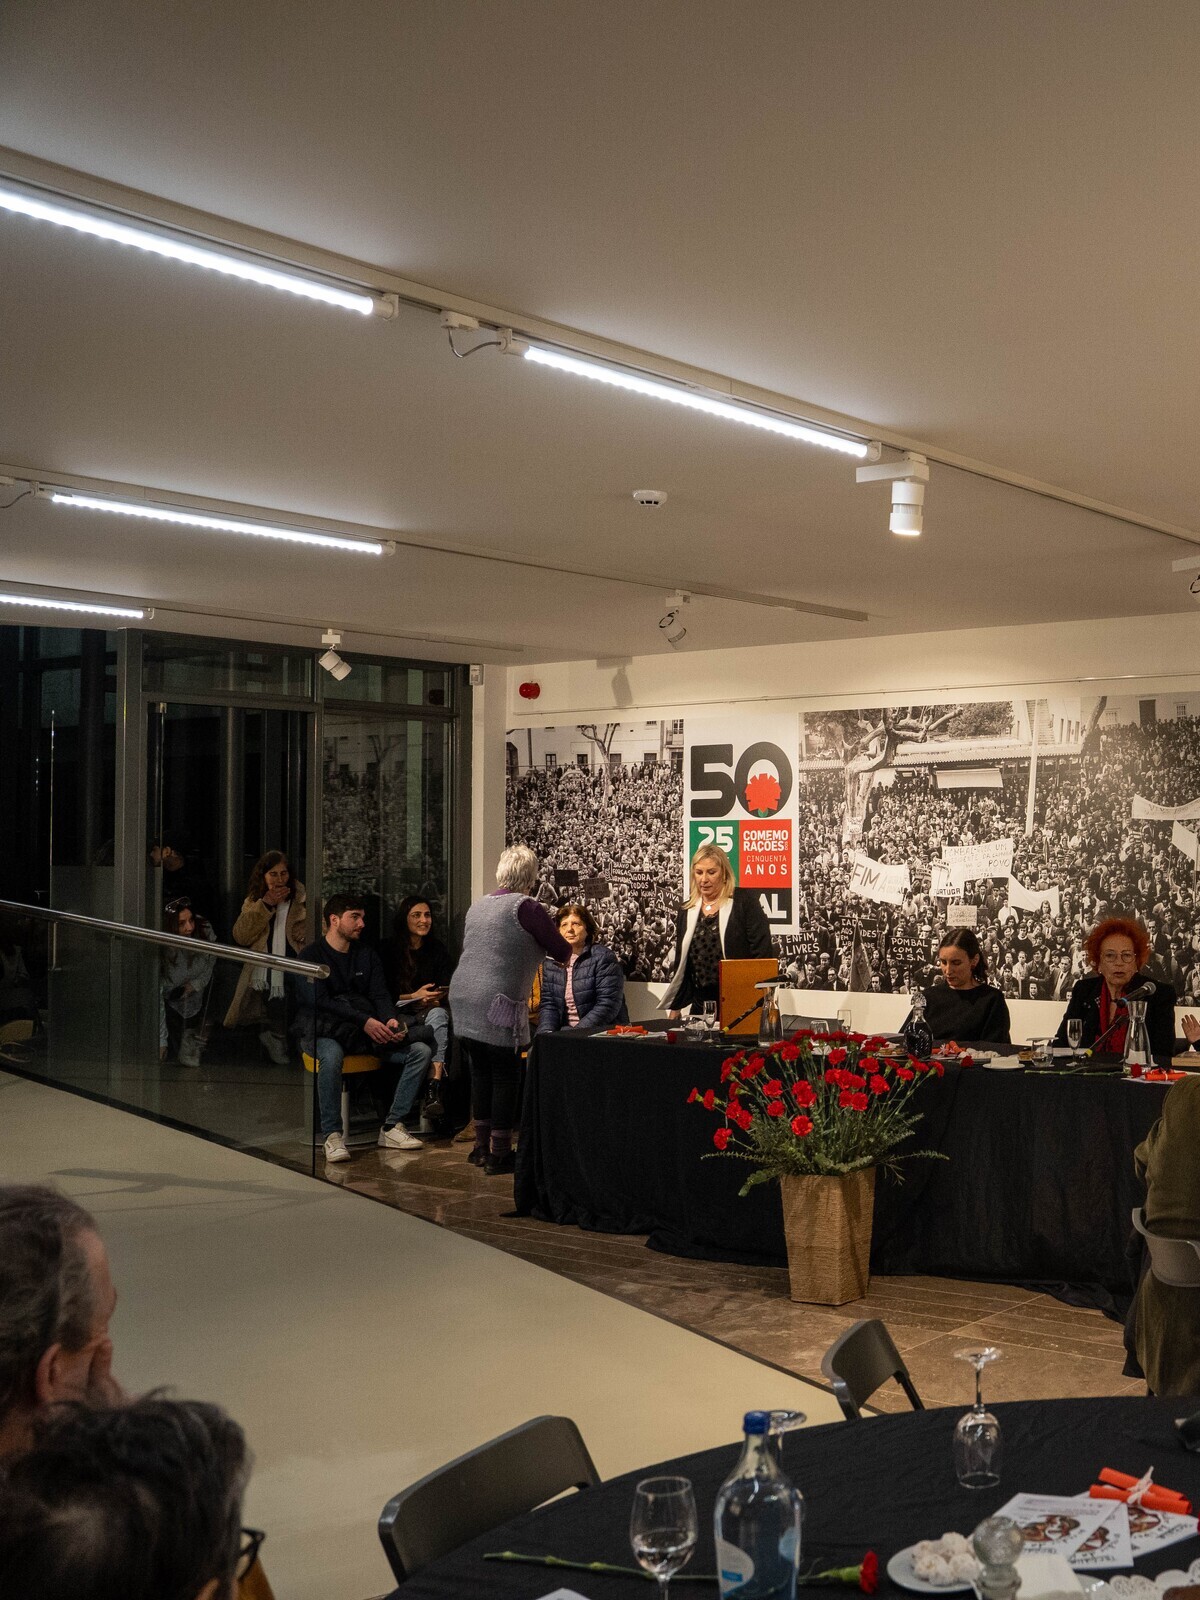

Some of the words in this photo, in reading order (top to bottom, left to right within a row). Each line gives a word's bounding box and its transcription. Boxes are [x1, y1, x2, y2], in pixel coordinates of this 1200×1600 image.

[690, 741, 793, 818] 50
[743, 829, 789, 841] COMEMO
[743, 838, 785, 853] RAÇÕES
[746, 855, 787, 863] CINQUENTA
[988, 859, 1011, 868] POVO
[745, 864, 788, 876] ANOS
[852, 862, 881, 890] FIM
[630, 881, 649, 889] TODOS
[665, 891, 680, 903] VIVA
[785, 932, 818, 944] ENFIM,
[891, 937, 929, 948] POMBAL
[785, 942, 820, 956] LIVRES
[892, 946, 913, 954] COM
